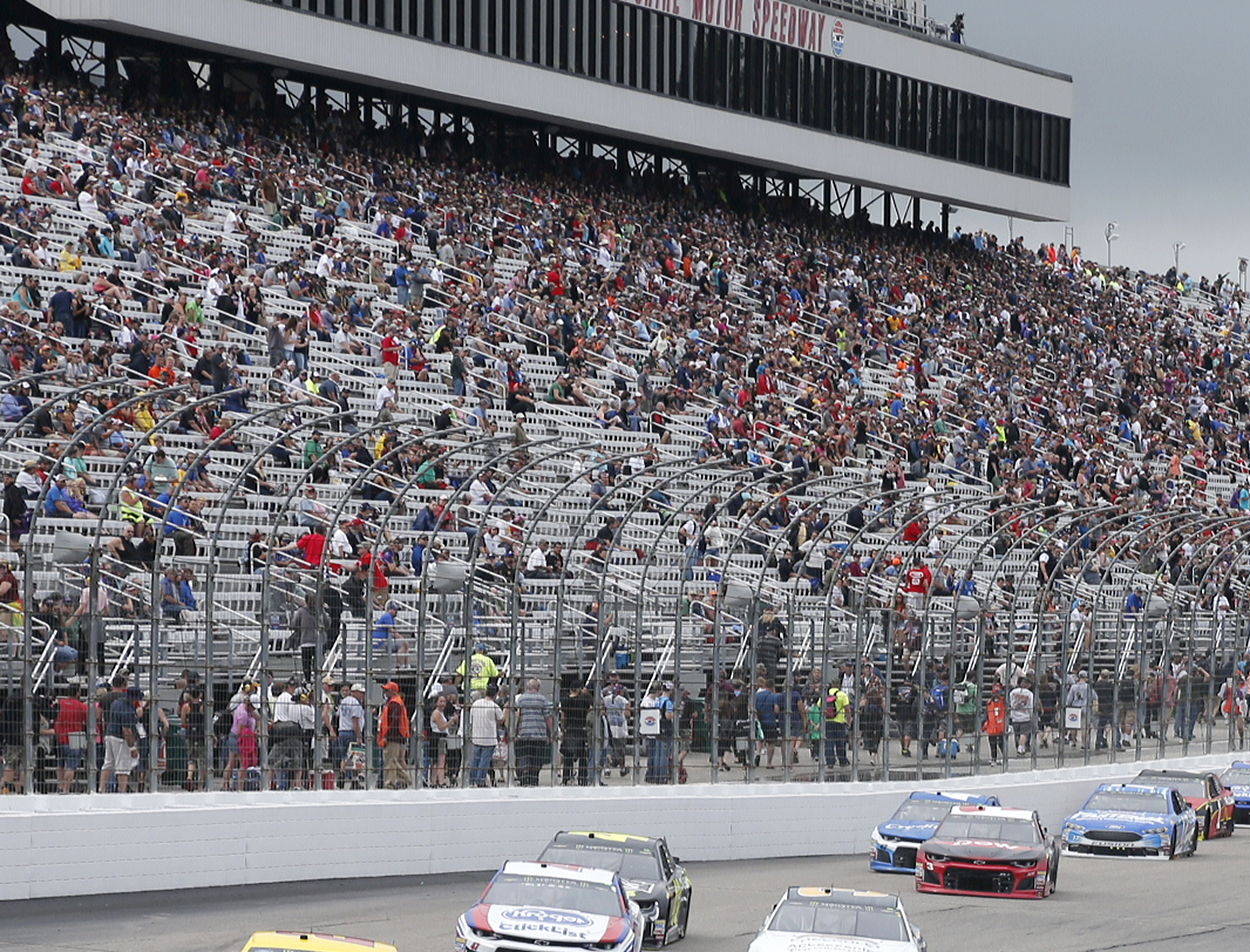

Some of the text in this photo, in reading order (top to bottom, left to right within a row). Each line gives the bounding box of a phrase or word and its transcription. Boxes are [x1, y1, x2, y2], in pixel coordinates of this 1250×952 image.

[692, 0, 742, 31] MOTOR
[752, 1, 826, 52] SPEEDWAY
[926, 862, 934, 871] 3
[499, 922, 588, 940] ClickList
